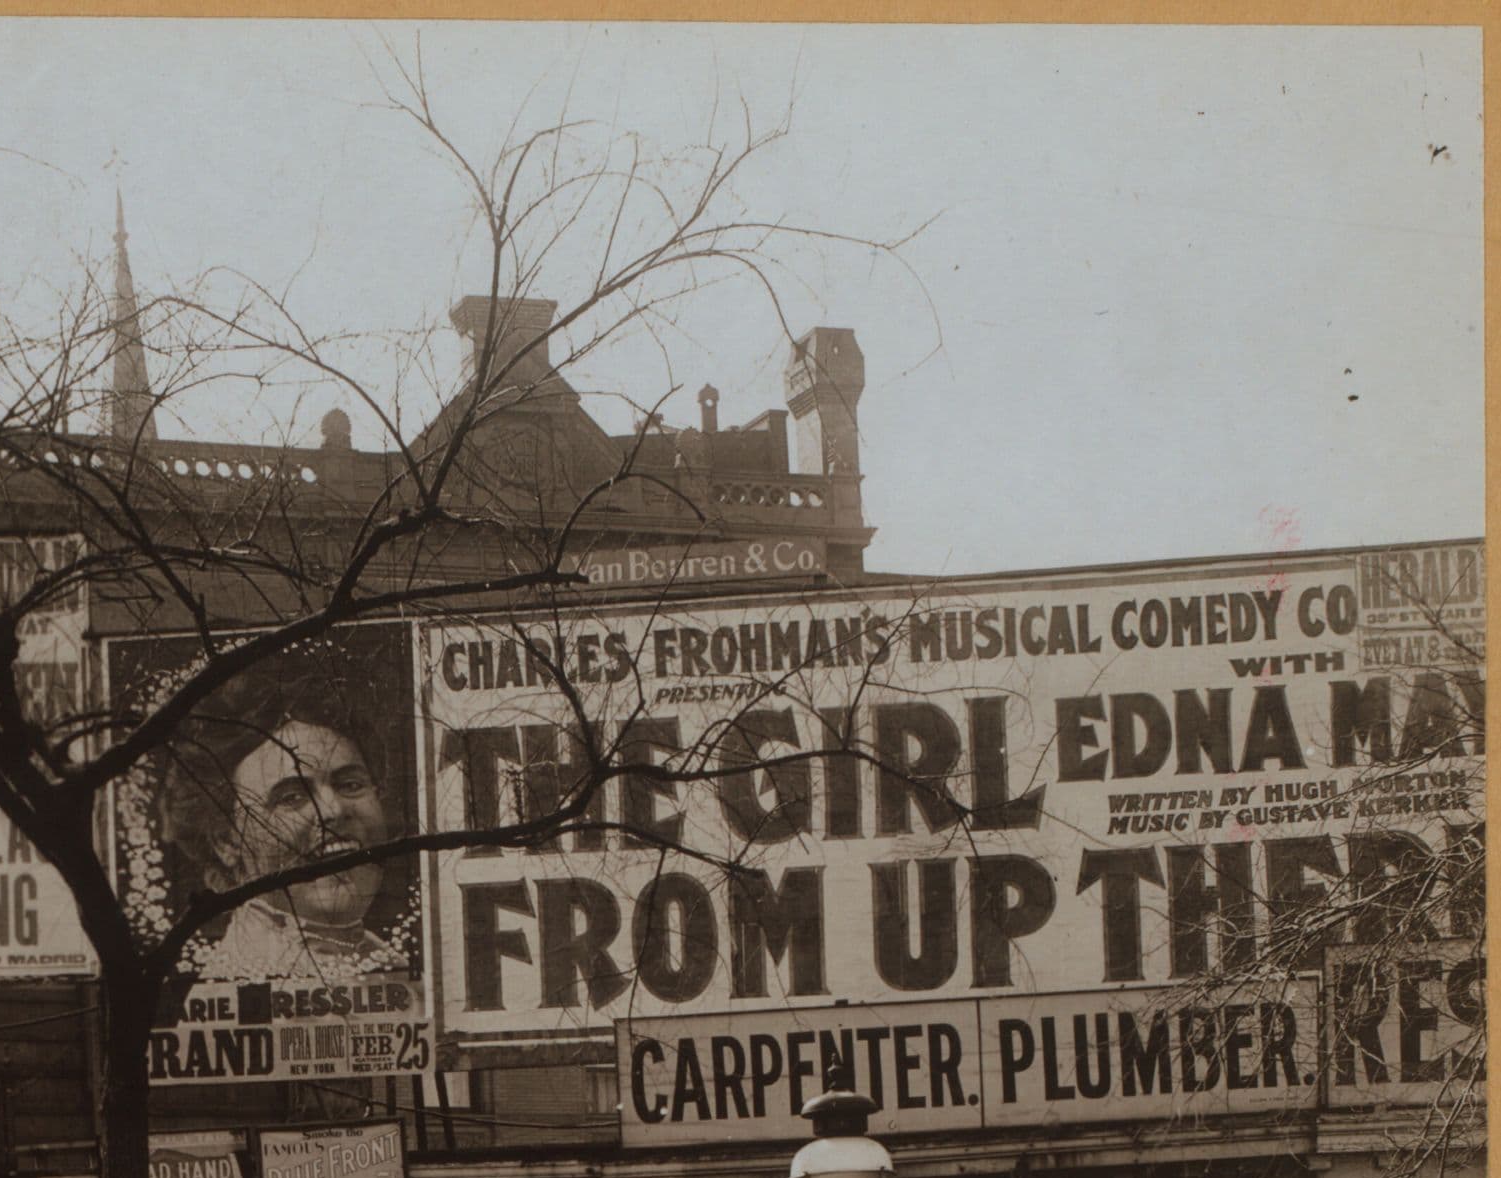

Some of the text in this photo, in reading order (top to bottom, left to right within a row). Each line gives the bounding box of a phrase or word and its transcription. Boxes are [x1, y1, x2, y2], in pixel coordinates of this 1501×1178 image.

[627, 550, 737, 584] Beuren
[743, 545, 769, 574] &
[772, 541, 822, 572] Co.
[1361, 549, 1478, 609] HERALD
[442, 583, 1358, 692] CHARLES FROHMAN'S MUSICAL COMEDY CO
[1229, 651, 1345, 679] WITH
[654, 678, 790, 705] PRESENTING
[1054, 684, 1308, 784] EDNA
[437, 692, 1047, 860] THE GIRL
[1108, 789, 1213, 815] WRITTEN
[1219, 785, 1257, 808] BY
[1265, 779, 1338, 802] HUGH
[1108, 812, 1189, 835] MUSIC
[1199, 808, 1230, 830] BY
[1235, 802, 1351, 827] GUSTAVE
[459, 864, 832, 1012] FROM
[870, 855, 1057, 992] UP
[7, 952, 87, 966] MADRID
[176, 997, 236, 1023] ARIE
[150, 1028, 274, 1079] RAND
[280, 1026, 312, 1061] OPERA
[315, 1024, 346, 1060] HOUSE
[290, 1022, 430, 1075] NEW YORK FEB. 25
[998, 1002, 1317, 1105] PLUMBER.
[631, 1023, 980, 1125] CARPENTER.
[263, 1141, 325, 1157] FAMOUS
[301, 1128, 344, 1140] Smoke
